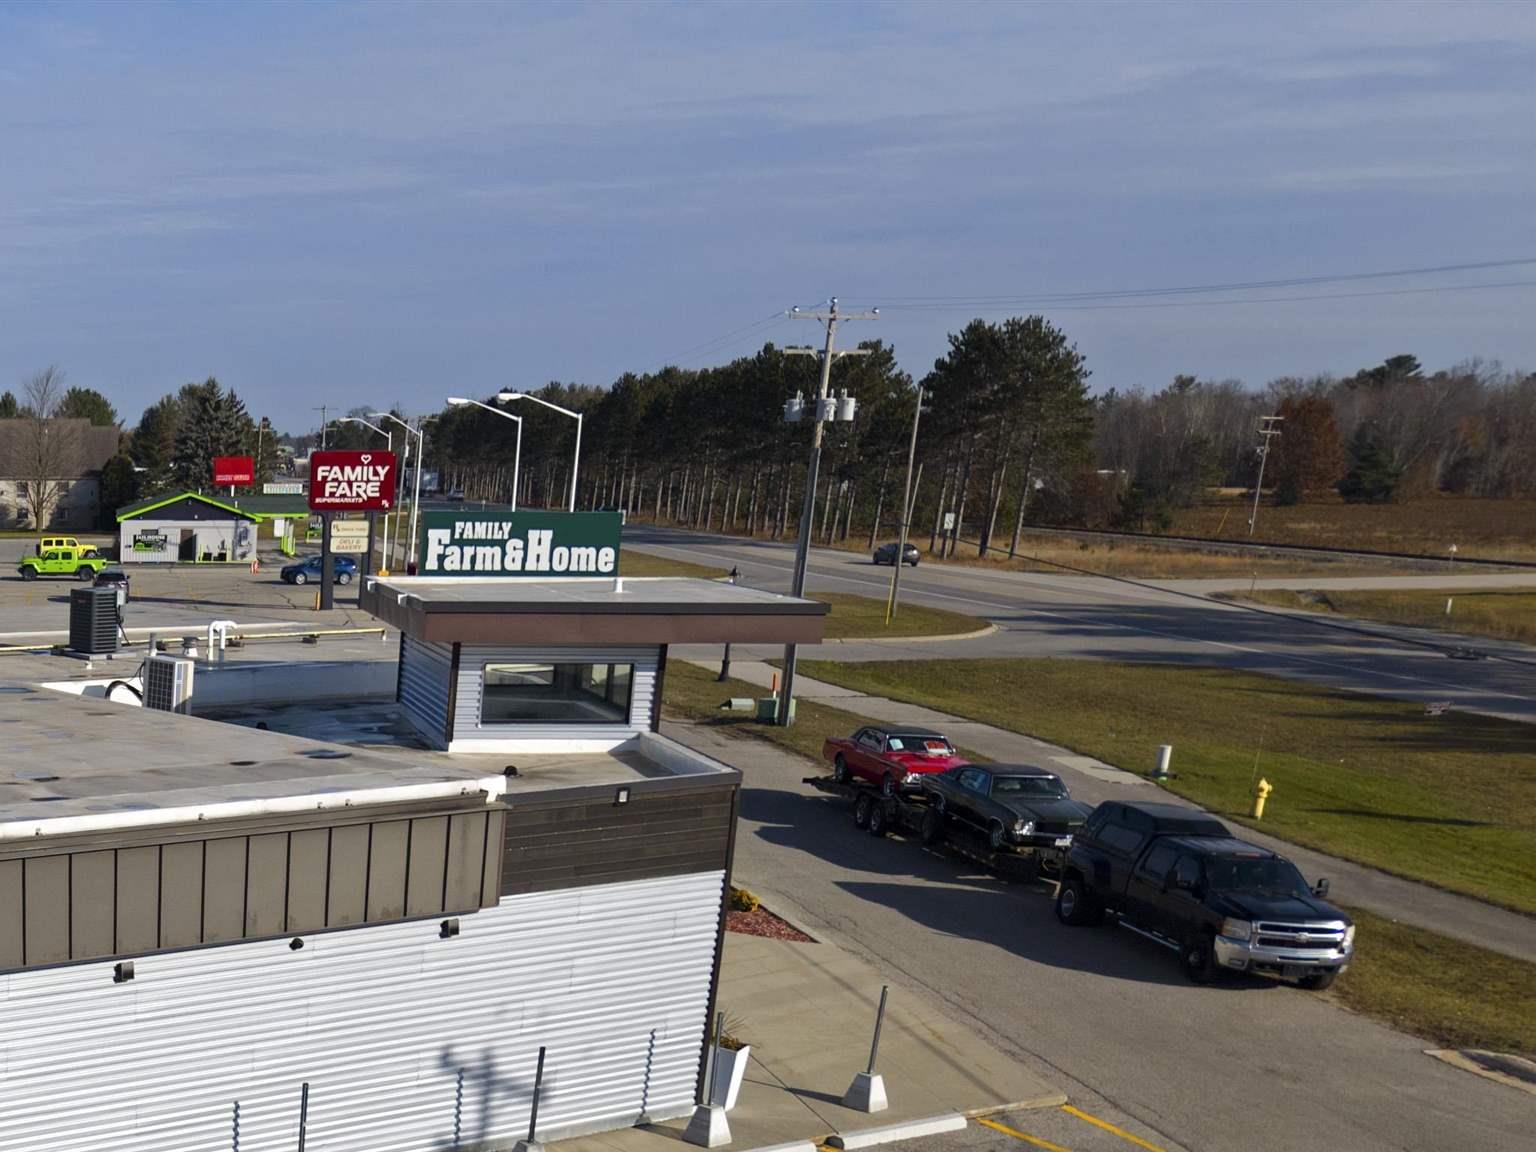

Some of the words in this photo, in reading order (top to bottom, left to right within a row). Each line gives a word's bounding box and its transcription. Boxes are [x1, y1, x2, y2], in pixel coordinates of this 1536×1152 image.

[317, 465, 390, 481] FAMILY
[325, 482, 381, 500] FARE
[454, 521, 513, 540] FAMILY
